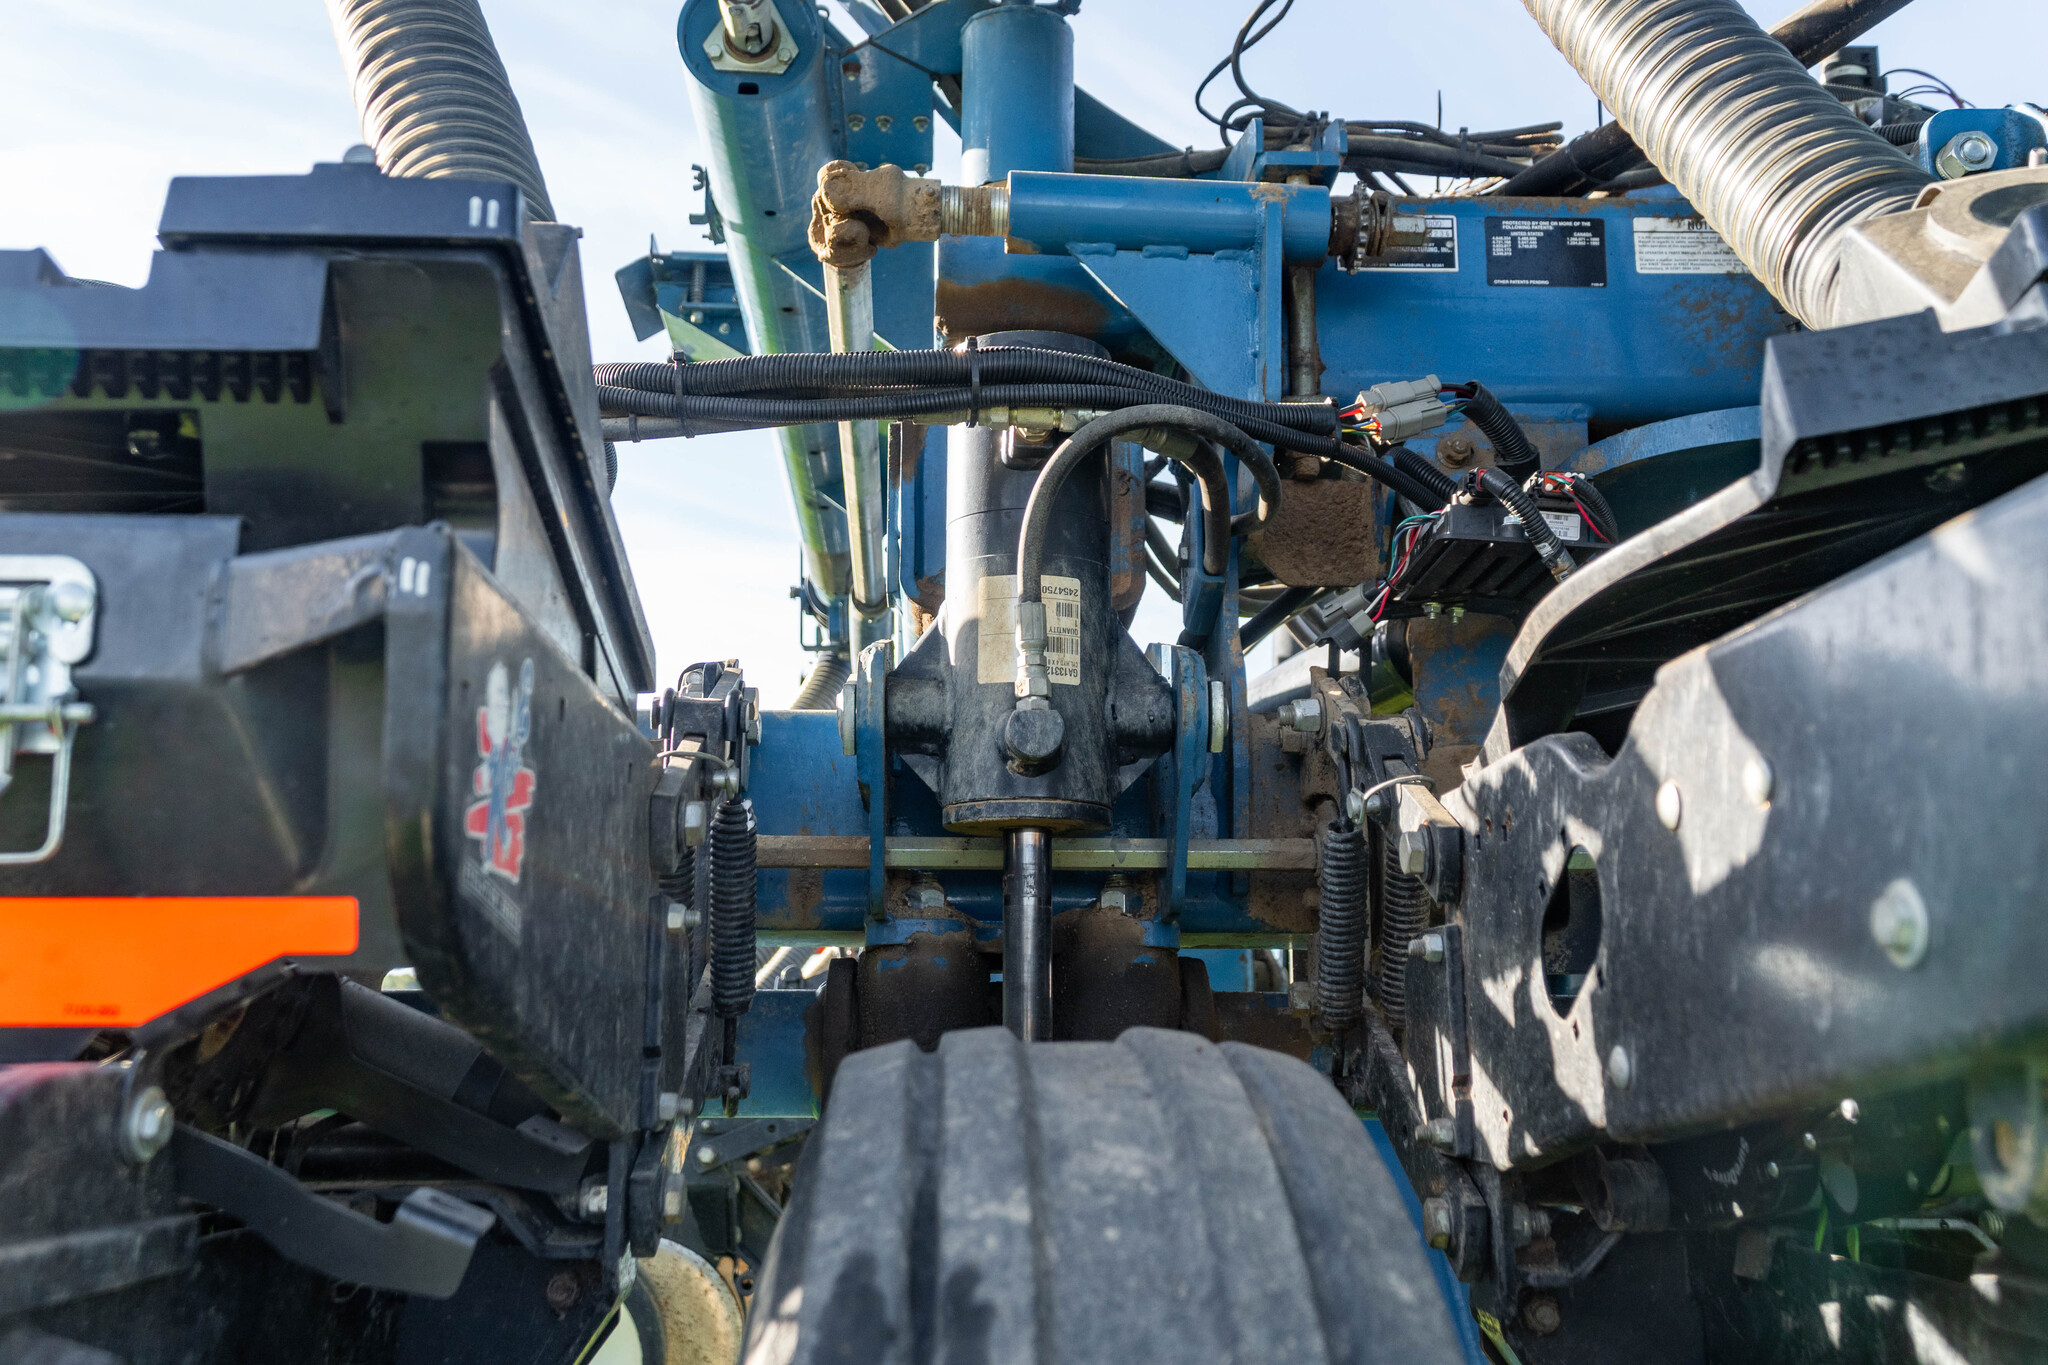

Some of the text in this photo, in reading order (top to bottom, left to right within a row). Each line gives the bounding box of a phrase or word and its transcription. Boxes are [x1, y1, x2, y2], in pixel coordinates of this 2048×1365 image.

[1688, 220, 1714, 230] NOT
[1042, 586, 1079, 597] 2454750
[1049, 627, 1079, 635] QUANTITY
